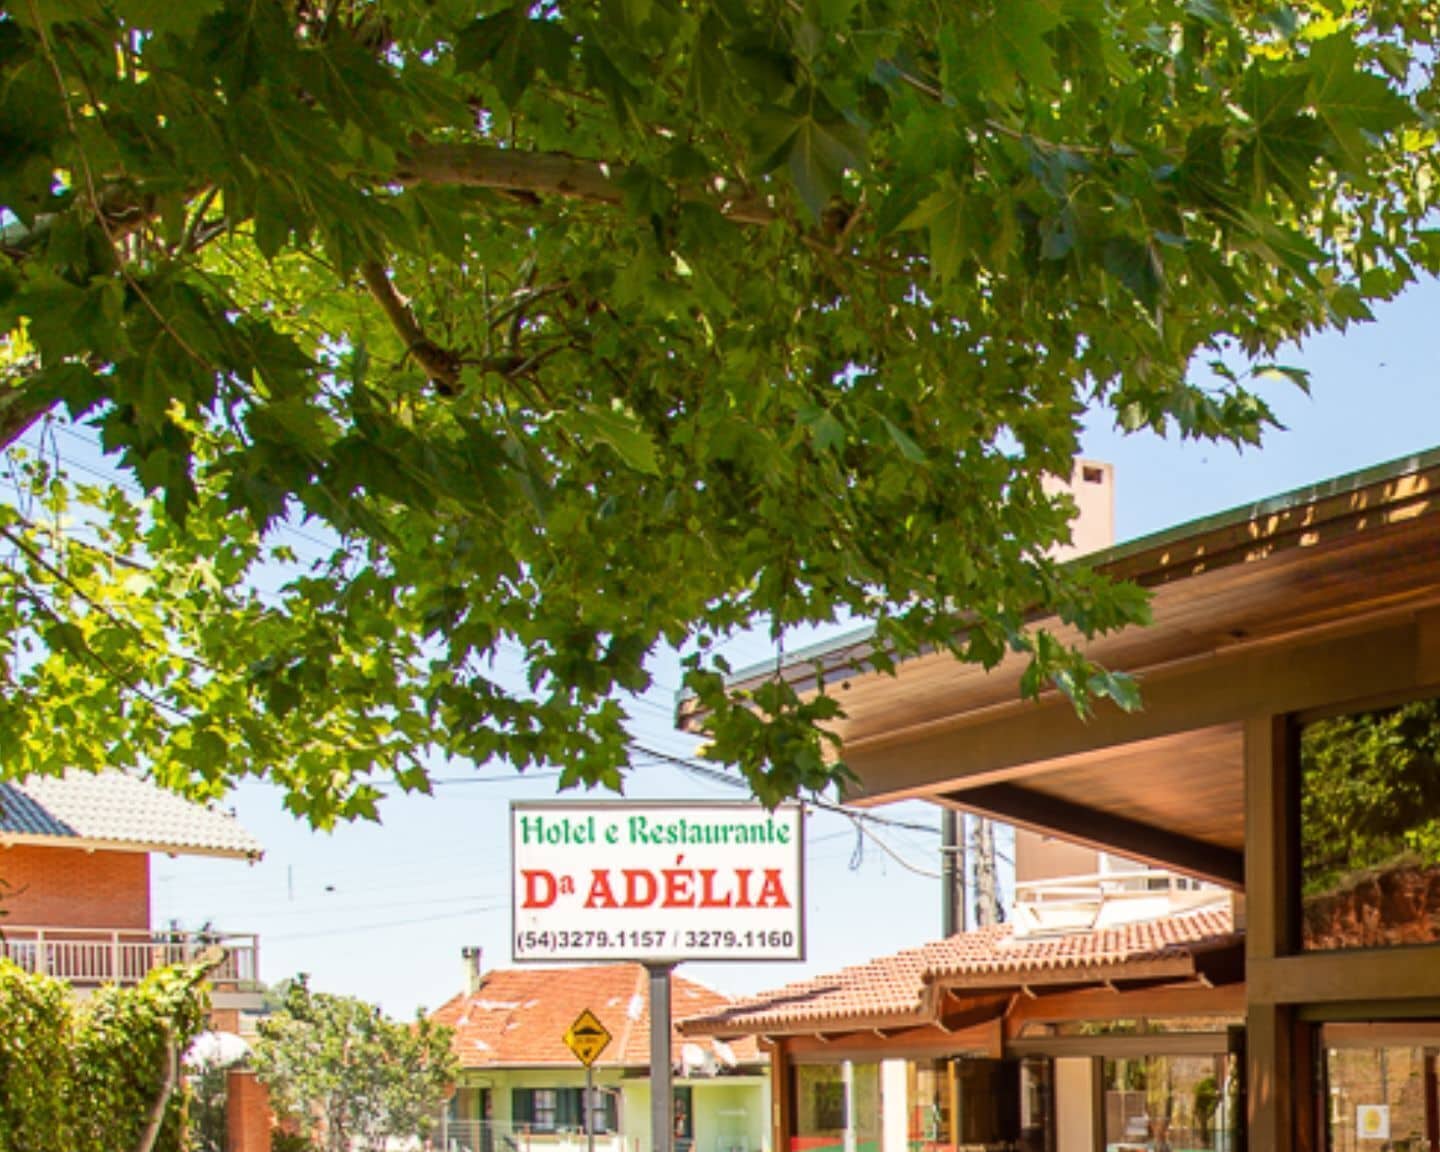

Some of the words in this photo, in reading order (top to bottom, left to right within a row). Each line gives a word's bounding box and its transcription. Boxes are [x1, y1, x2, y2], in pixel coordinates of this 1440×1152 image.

[519, 815, 596, 845] Hotel
[604, 824, 619, 845] e
[628, 815, 791, 845] Restaurante
[583, 853, 792, 909] ADÉLIA
[517, 930, 667, 952] (54)3279.1157
[685, 930, 794, 948] 3279.1160
